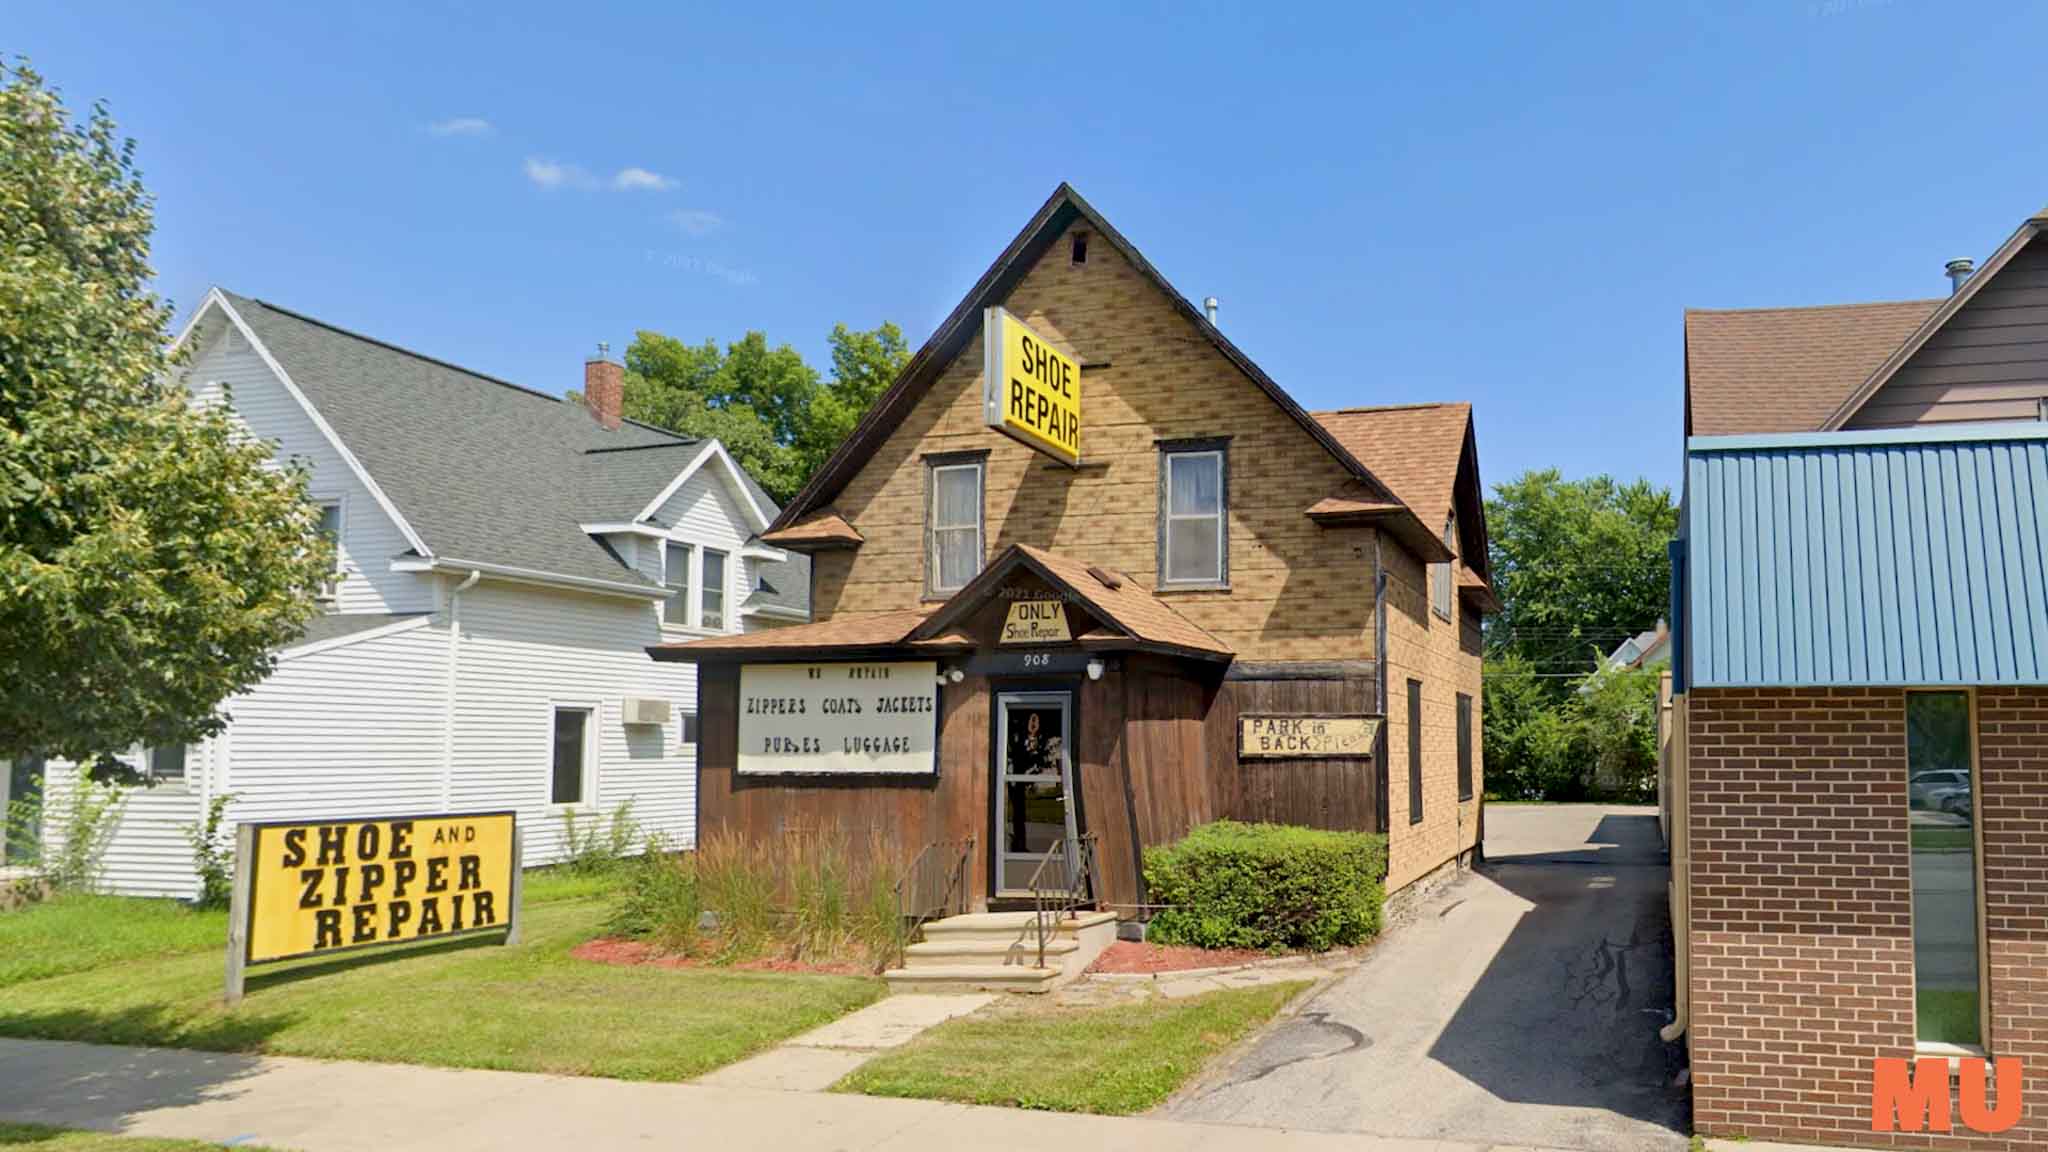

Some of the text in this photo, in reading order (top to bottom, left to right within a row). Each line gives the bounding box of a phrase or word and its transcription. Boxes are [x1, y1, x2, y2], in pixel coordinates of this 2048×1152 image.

[1022, 335, 1072, 399] SHOE
[1011, 378, 1079, 449] REPAIR
[1019, 603, 1060, 620] ONLY
[1031, 621, 1060, 640] Repair
[1024, 653, 1051, 667] 908
[746, 696, 933, 714] ZIPPERS COATS JACKETS
[1253, 719, 1304, 735] PARK
[764, 737, 911, 754] PURSES LUGGAGE
[1260, 736, 1311, 751] BACK
[282, 821, 476, 869] SHOE AND
[299, 854, 482, 909] ZIPPER
[314, 890, 496, 950] REPAIR
